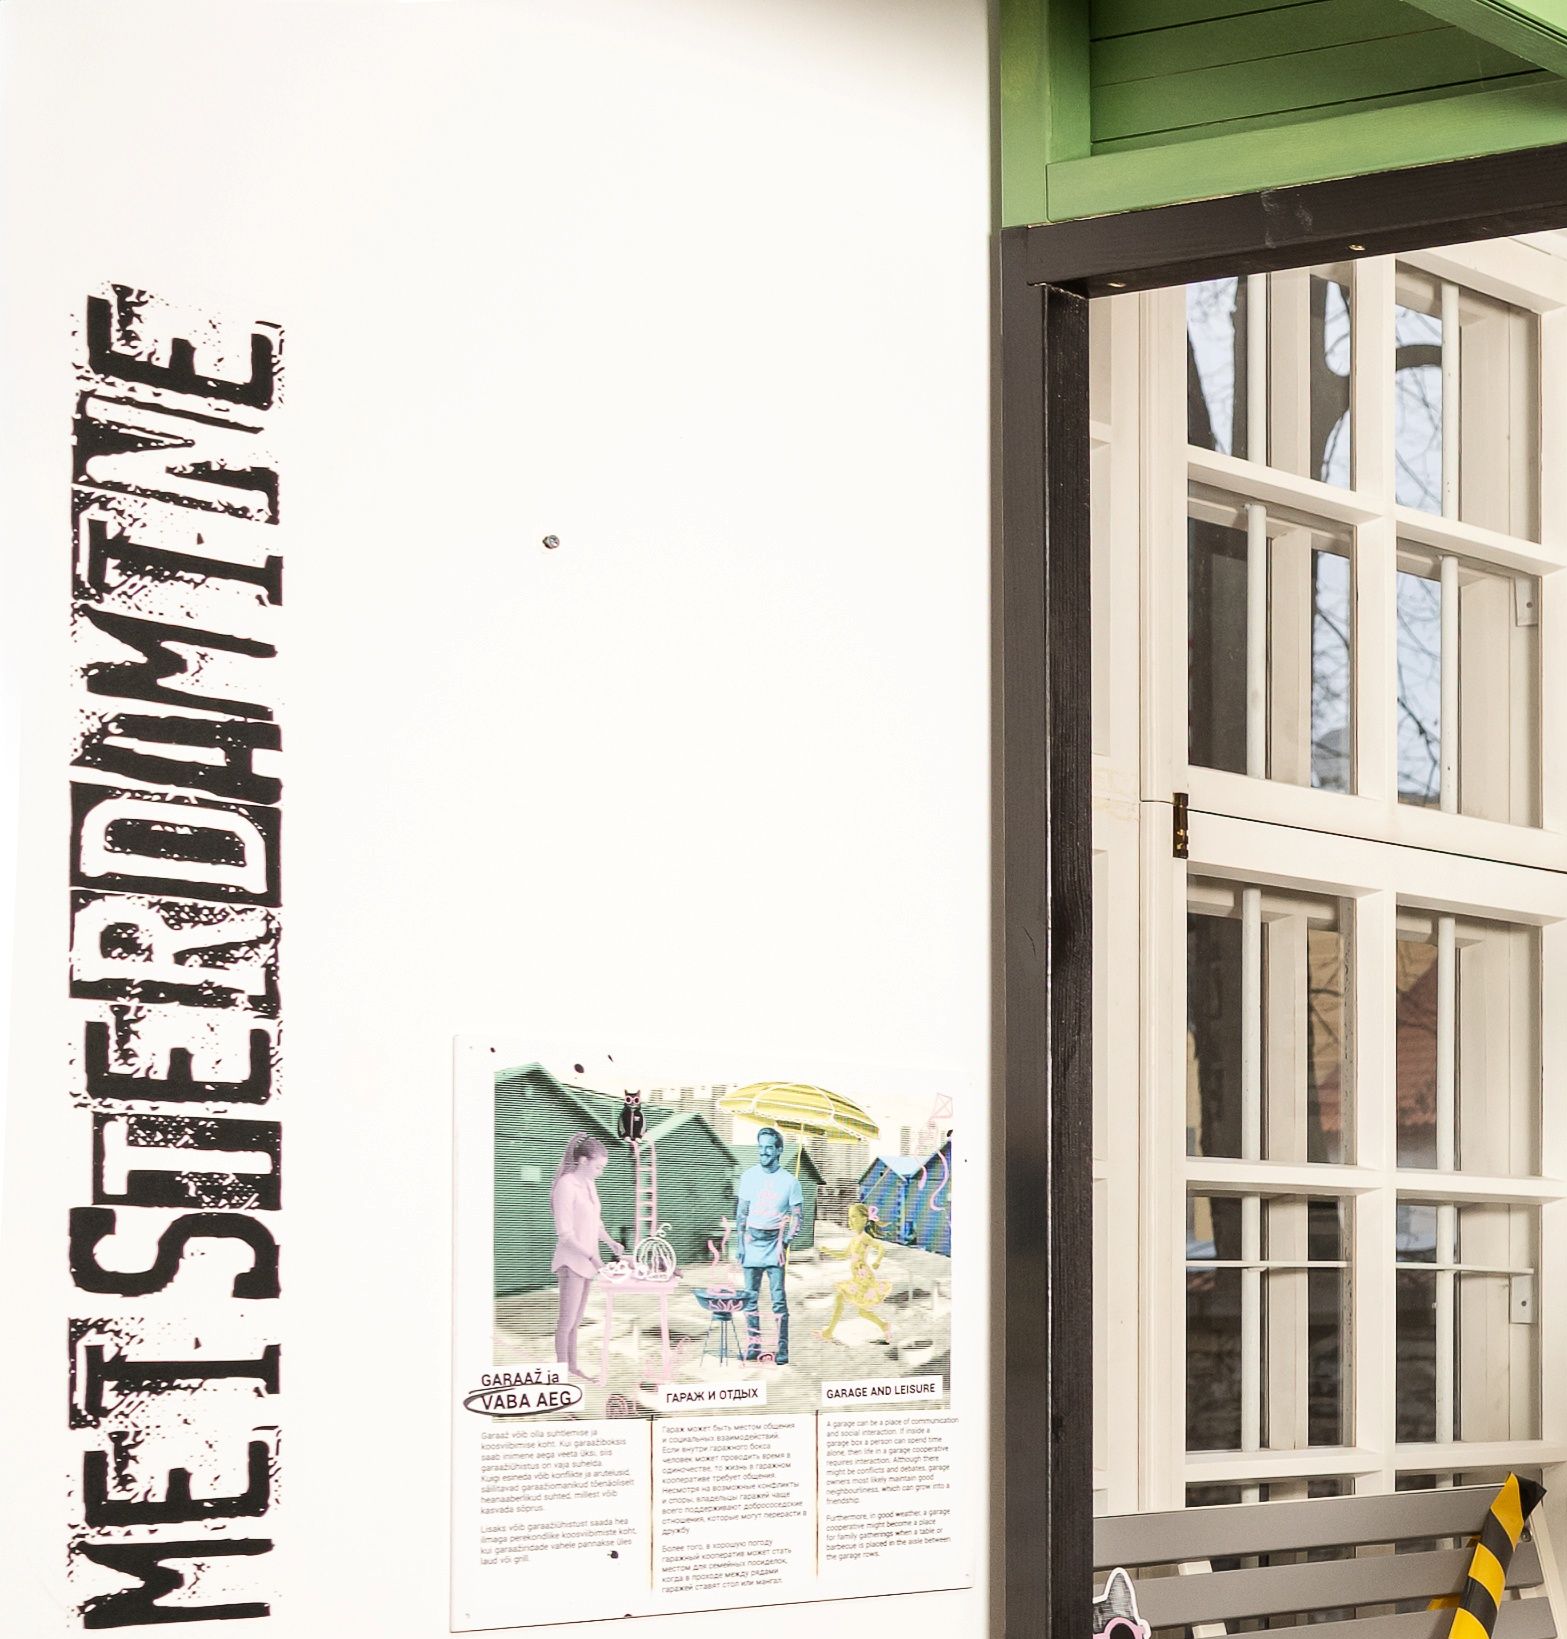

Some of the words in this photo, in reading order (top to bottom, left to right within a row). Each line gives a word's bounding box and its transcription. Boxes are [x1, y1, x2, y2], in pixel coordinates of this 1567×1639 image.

[67, 280, 291, 1622] MEISTERDAMINE
[481, 1369, 542, 1387] GARAAŽ
[546, 1372, 560, 1385] ja
[666, 1389, 705, 1403] ГАРАЖ
[708, 1391, 716, 1401] И
[719, 1388, 759, 1401] ОТДЫХ
[826, 1386, 868, 1399] GARAGE
[871, 1385, 892, 1396] AND
[894, 1383, 935, 1395] LEISURE
[481, 1392, 531, 1410] VABA
[537, 1391, 572, 1407] AEG
